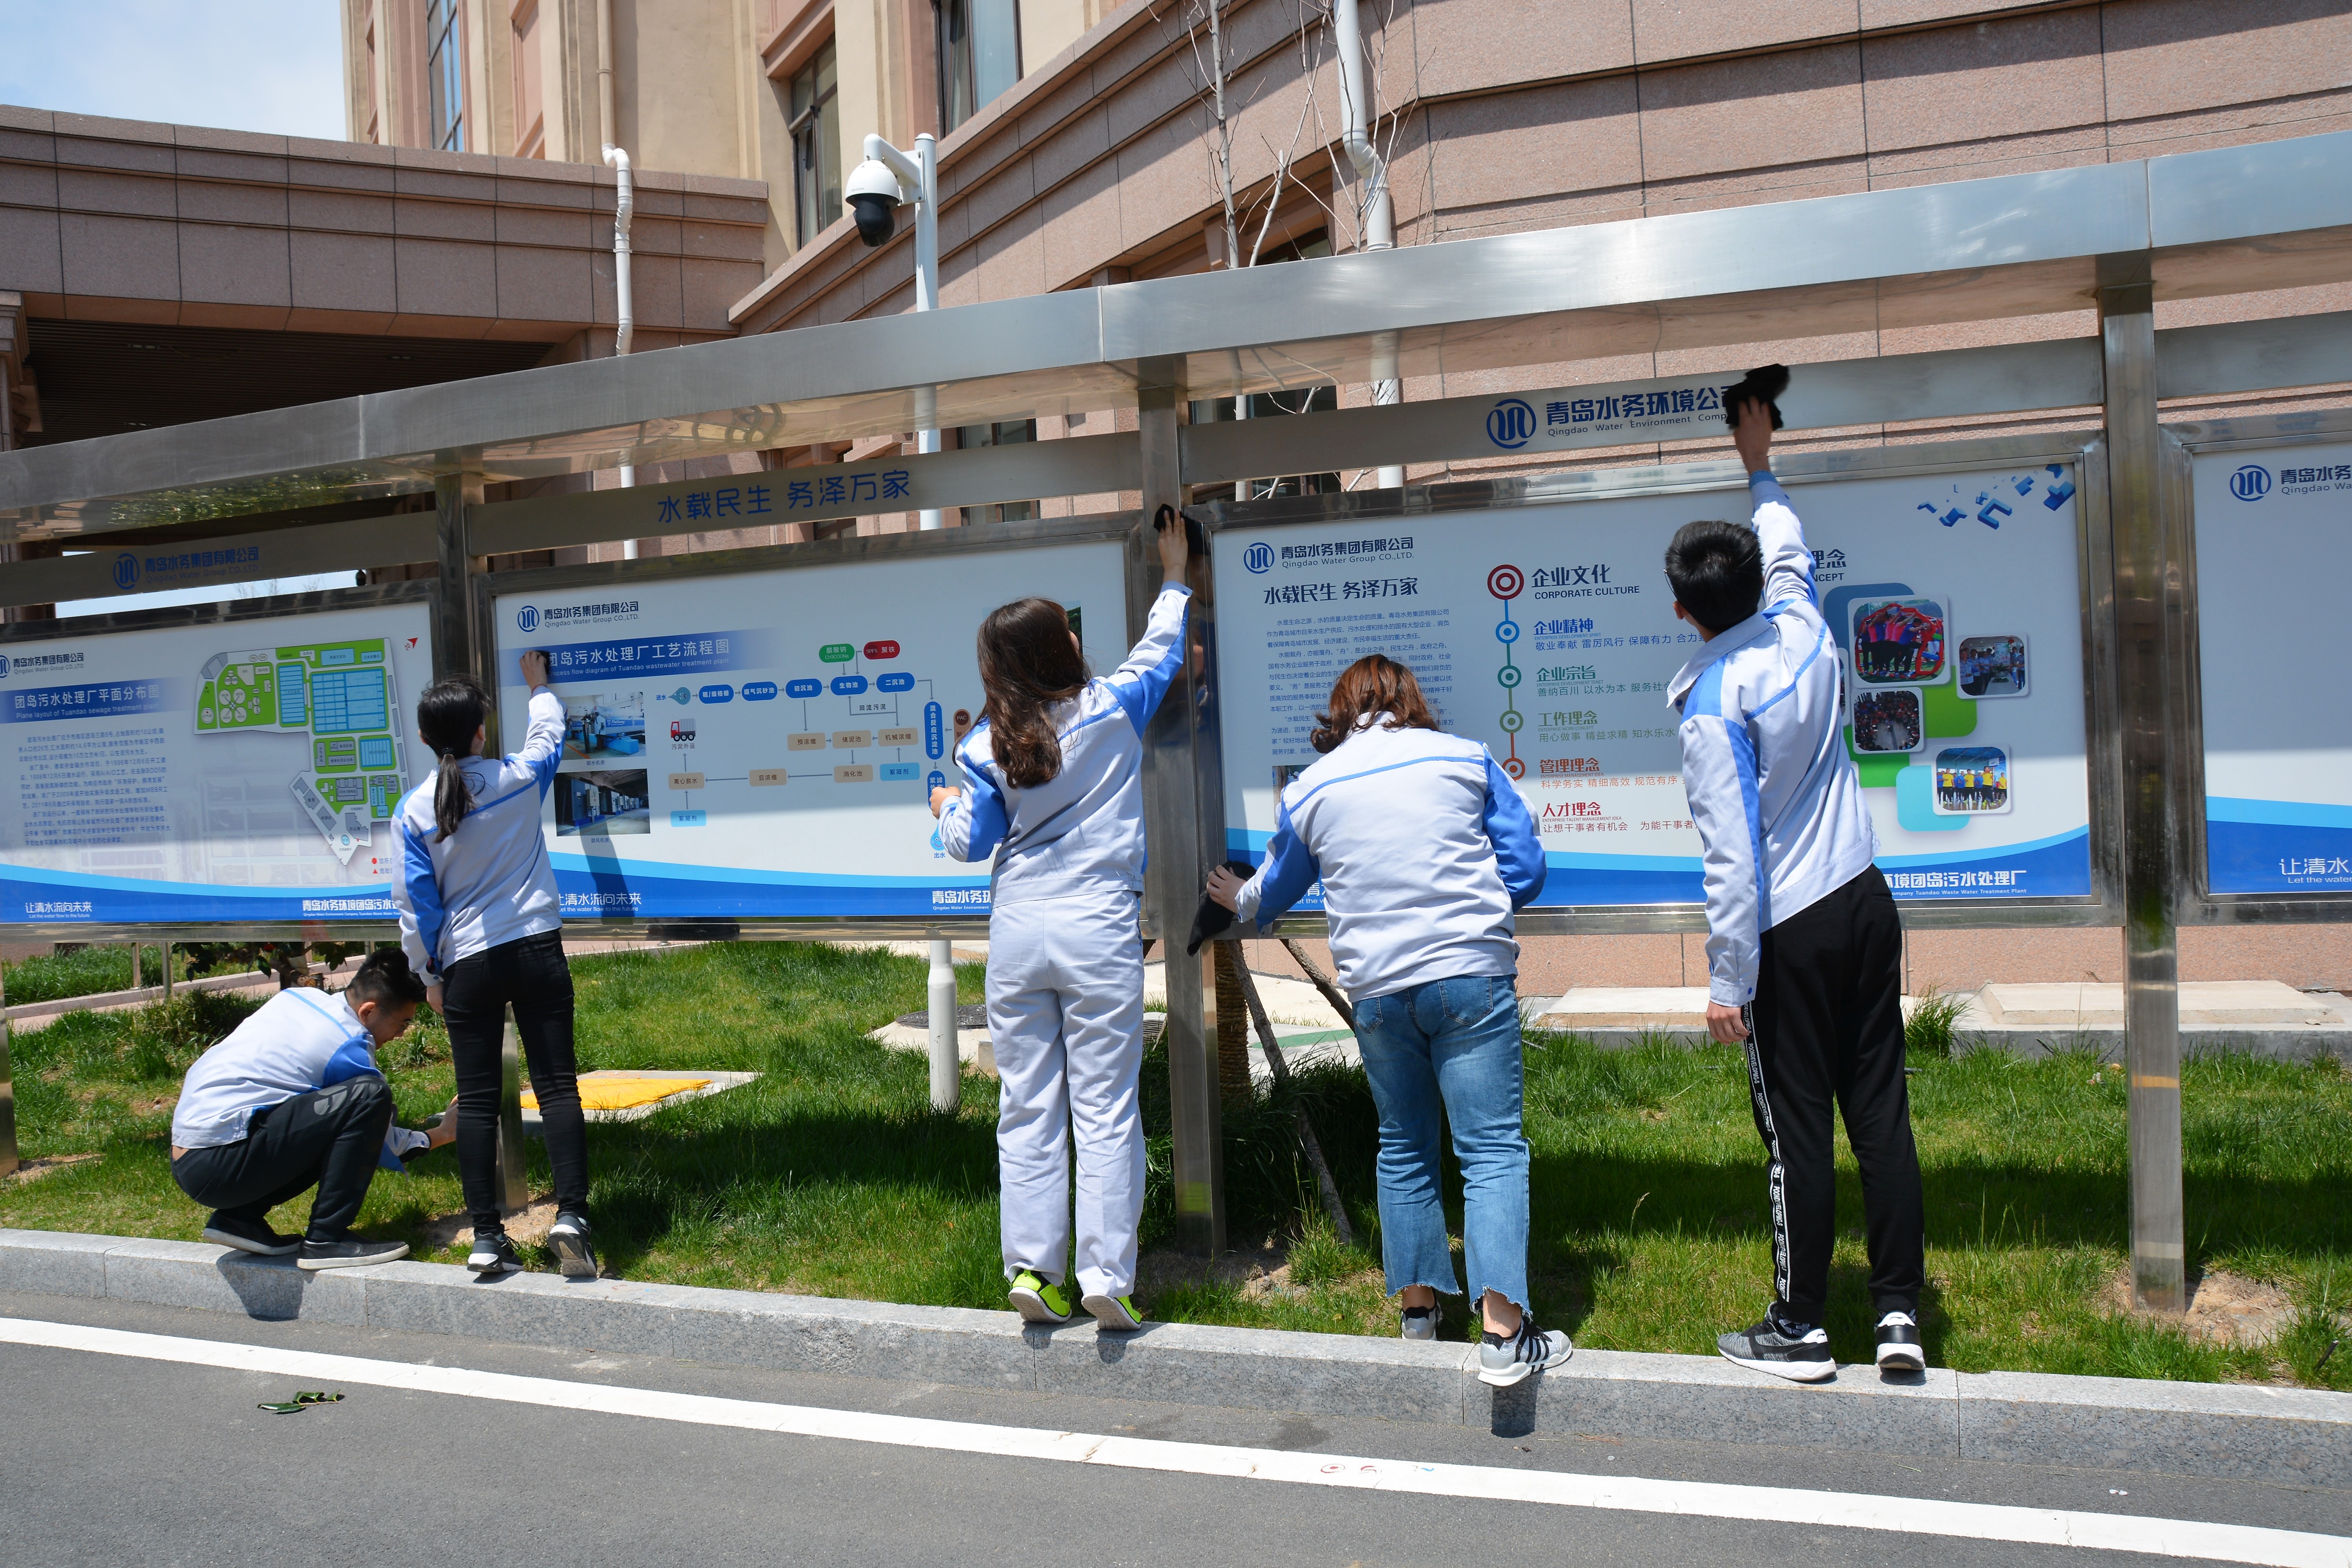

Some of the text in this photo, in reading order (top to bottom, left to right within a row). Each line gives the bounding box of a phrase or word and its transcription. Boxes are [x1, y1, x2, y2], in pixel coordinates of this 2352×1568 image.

[1548, 426, 1588, 437] Qingdao
[1595, 423, 1623, 432] Water
[1630, 417, 1691, 429] Environment
[2280, 465, 2351, 484] 青岛水务
[658, 469, 910, 524] 水载民生 务泽万家
[2282, 485, 2330, 495] Qingdao
[1281, 537, 1414, 559] 青岛水务集团有限公司
[145, 547, 259, 573] 青岛水务集团有限公司
[1282, 559, 1318, 569] Qingdao
[1349, 555, 1376, 564] Group
[146, 573, 177, 583] Qingdao
[179, 571, 201, 579] Water
[204, 567, 226, 578] Group
[1531, 564, 1611, 588] 企业文化
[1264, 577, 1418, 604] 水载民生 务泽万家
[1535, 586, 1640, 599] CORPORATE CULTURE
[544, 601, 639, 620] 青岛水务集团有限公司
[545, 619, 571, 627] Qingdao
[1534, 618, 1593, 635] 企业精神
[1536, 634, 1671, 651] 敬业奉献 雷厉风行 保障有力
[14, 653, 84, 668] 青岛水务集团有限公司
[549, 639, 730, 667] 团岛污水处理厂工艺流程图
[585, 666, 609, 676] diagram
[682, 659, 712, 667] treatment
[1536, 665, 1596, 682] 企业宗旨
[15, 685, 159, 709] 团岛污水处理厂平面分布图
[1538, 684, 1626, 697] 善纳百川 以水为本
[1538, 710, 1598, 727] 工作理念
[930, 705, 938, 755] 混合反应沉淀池
[1539, 728, 1675, 742] 用心做事 精益求精 知水乐水
[1540, 757, 1600, 773] 管理理念
[1541, 775, 1677, 789] 科学务实 精细高效 规范有序
[1543, 801, 1602, 818] 人才理念
[1543, 820, 1698, 833] 让想干事者有机会 为能干事者
[25, 901, 93, 913] 让清水流向未来
